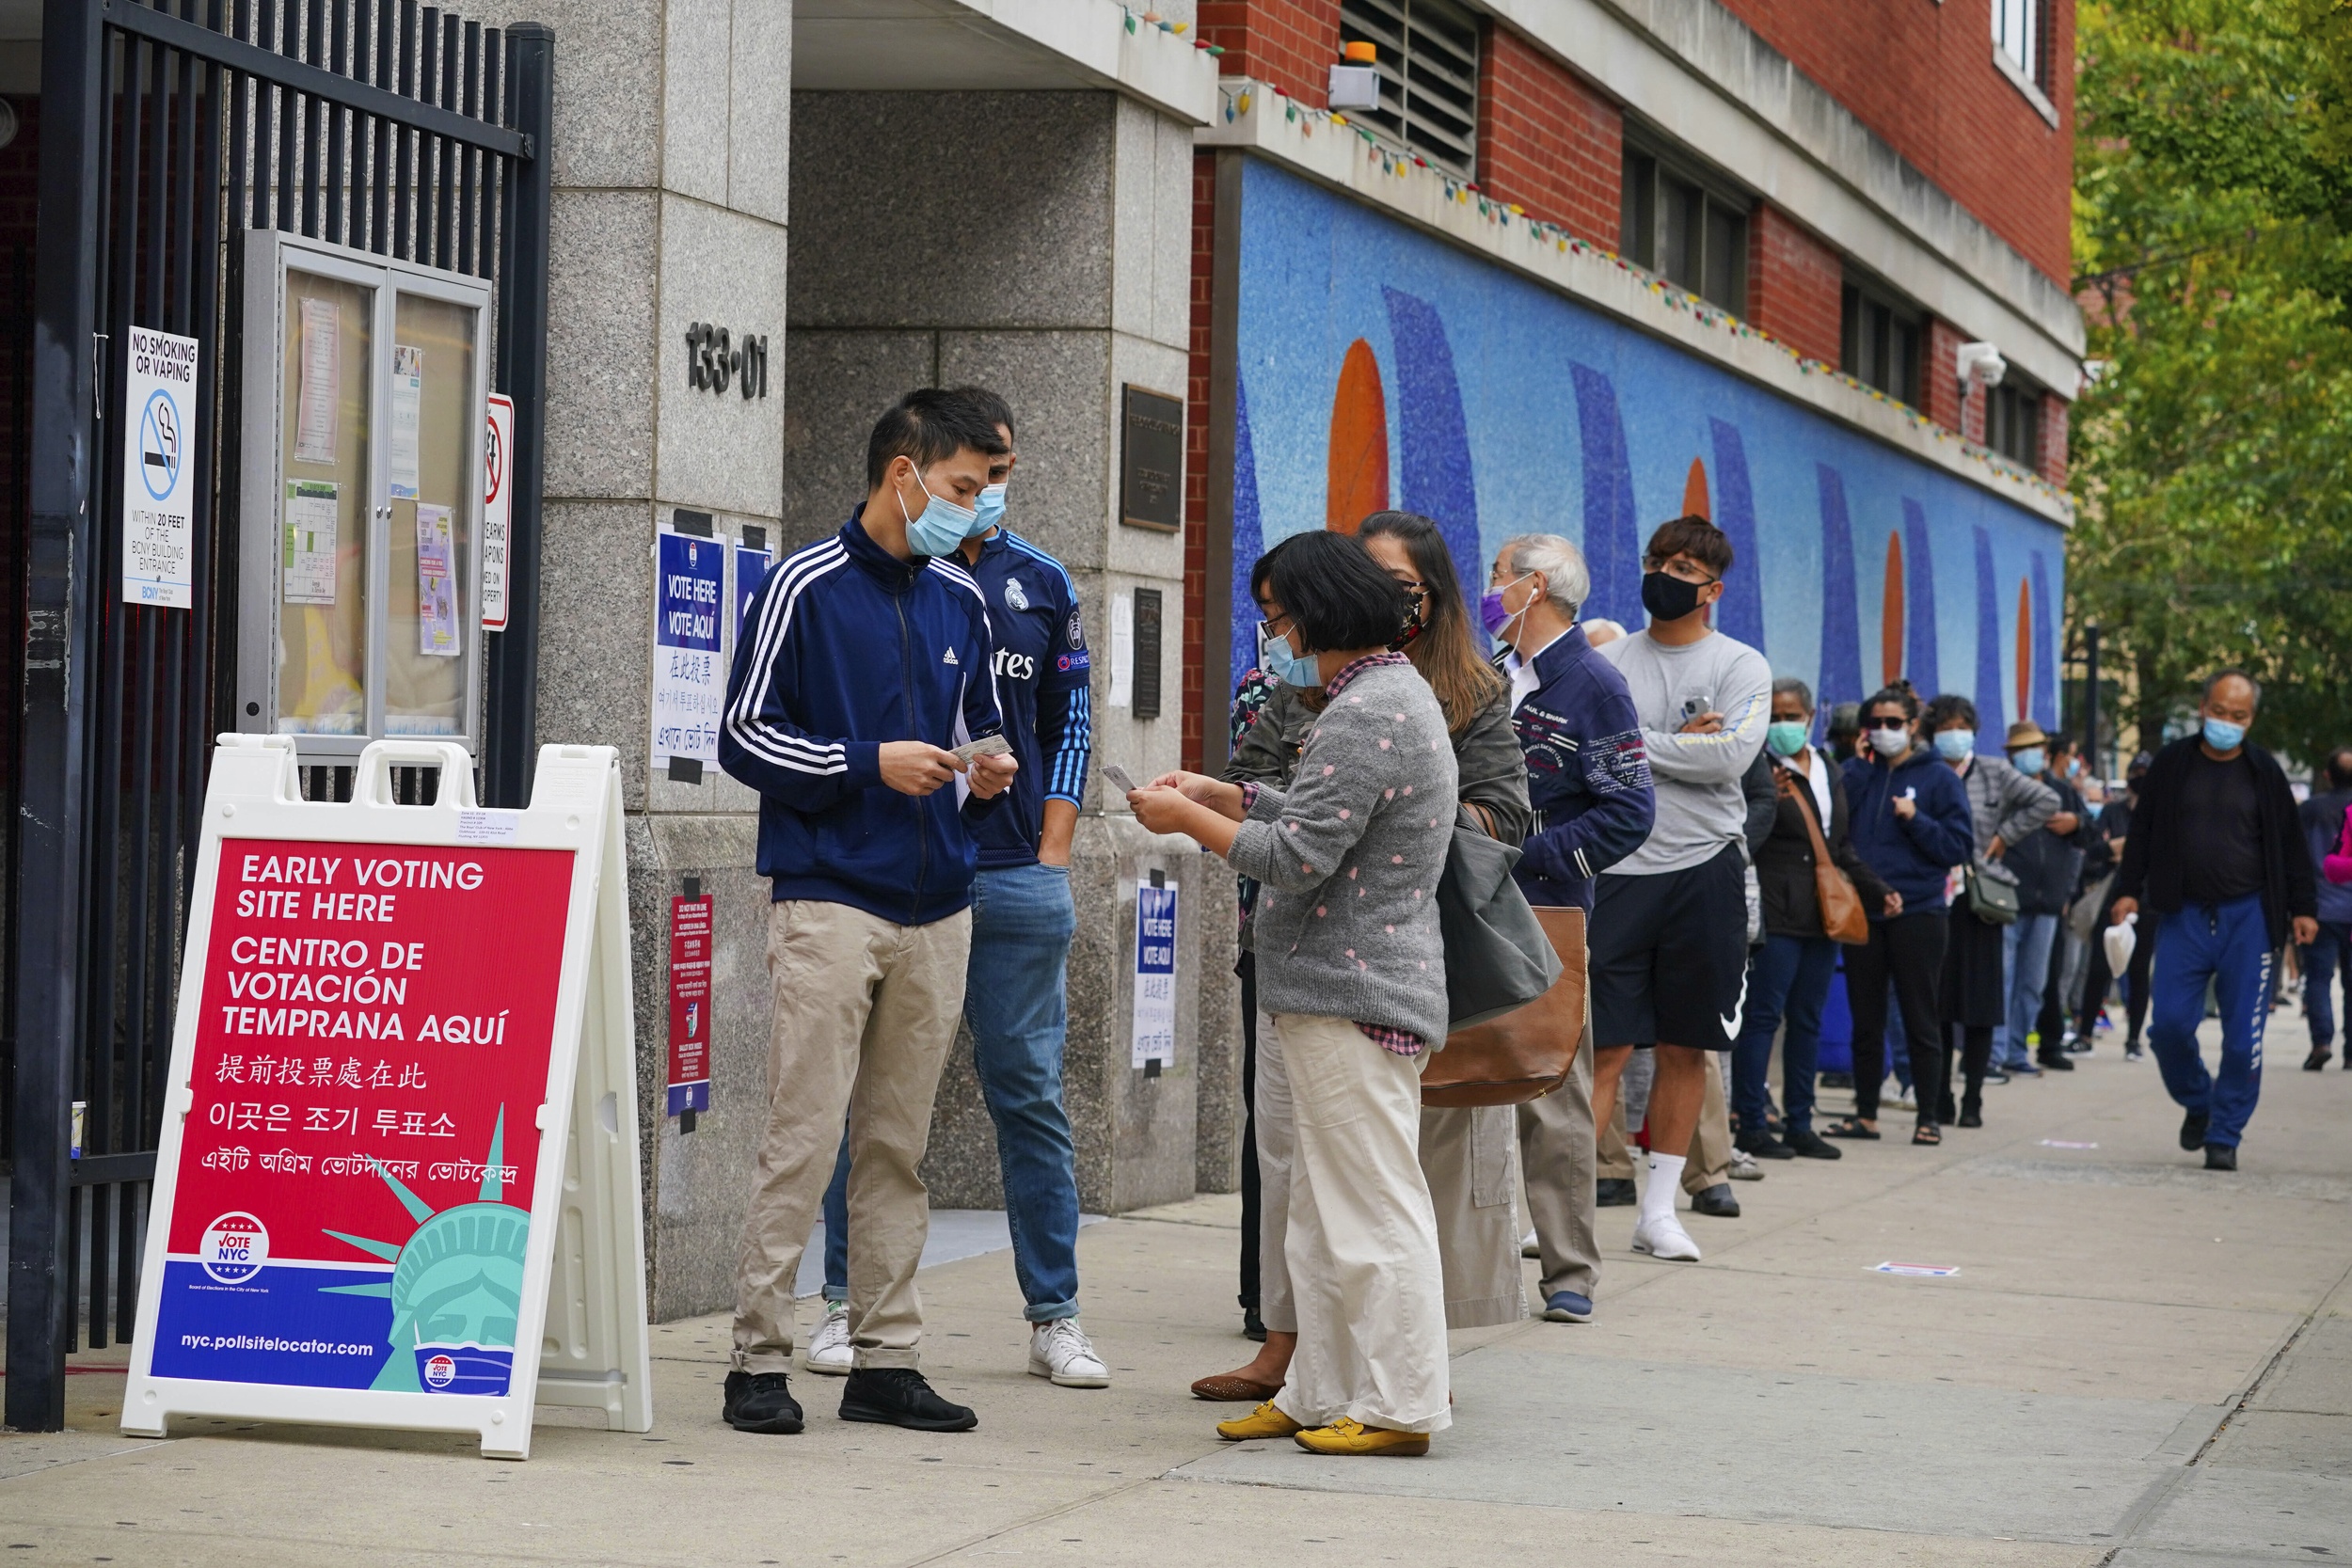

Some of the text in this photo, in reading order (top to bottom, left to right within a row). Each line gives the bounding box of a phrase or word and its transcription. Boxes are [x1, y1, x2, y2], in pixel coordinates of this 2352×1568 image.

[133, 333, 195, 363] NO SMOKING
[136, 355, 190, 383] OR VAPING
[132, 509, 185, 529] WITHIN 20 FEET
[485, 522, 504, 541] EARMS
[144, 527, 169, 543] OF THE
[132, 540, 184, 560] BCNY BUILDING
[485, 545, 504, 564] APONS
[139, 557, 176, 575] ENTRANCE
[493, 572, 500, 585] ON
[142, 586, 159, 599] BCNY
[484, 589, 502, 603] OPERTY
[668, 574, 717, 604] VOTE HERE
[668, 610, 715, 640] VOTE AQUÍ
[670, 650, 710, 686] 在此投票
[995, 646, 1034, 680] tes
[241, 854, 484, 891] EARLY VOTING
[236, 889, 396, 922] SITE HERE
[1143, 918, 1172, 938] VOTE HERE
[230, 935, 424, 971] CENTRO DE
[1143, 945, 1158, 965] VOTE
[228, 967, 407, 1006] VOTACIÓN
[222, 1006, 510, 1045] TEMPRANA AQUÍ
[215, 1052, 427, 1090] 提前投票處在此
[209, 1101, 456, 1137] 이곳은 조기 투표소
[201, 1146, 251, 1173] এইটি
[259, 1148, 313, 1175] অগ্রিম
[218, 1247, 249, 1261] NYC
[181, 1334, 373, 1356] nyc.pollsitelocator.com
